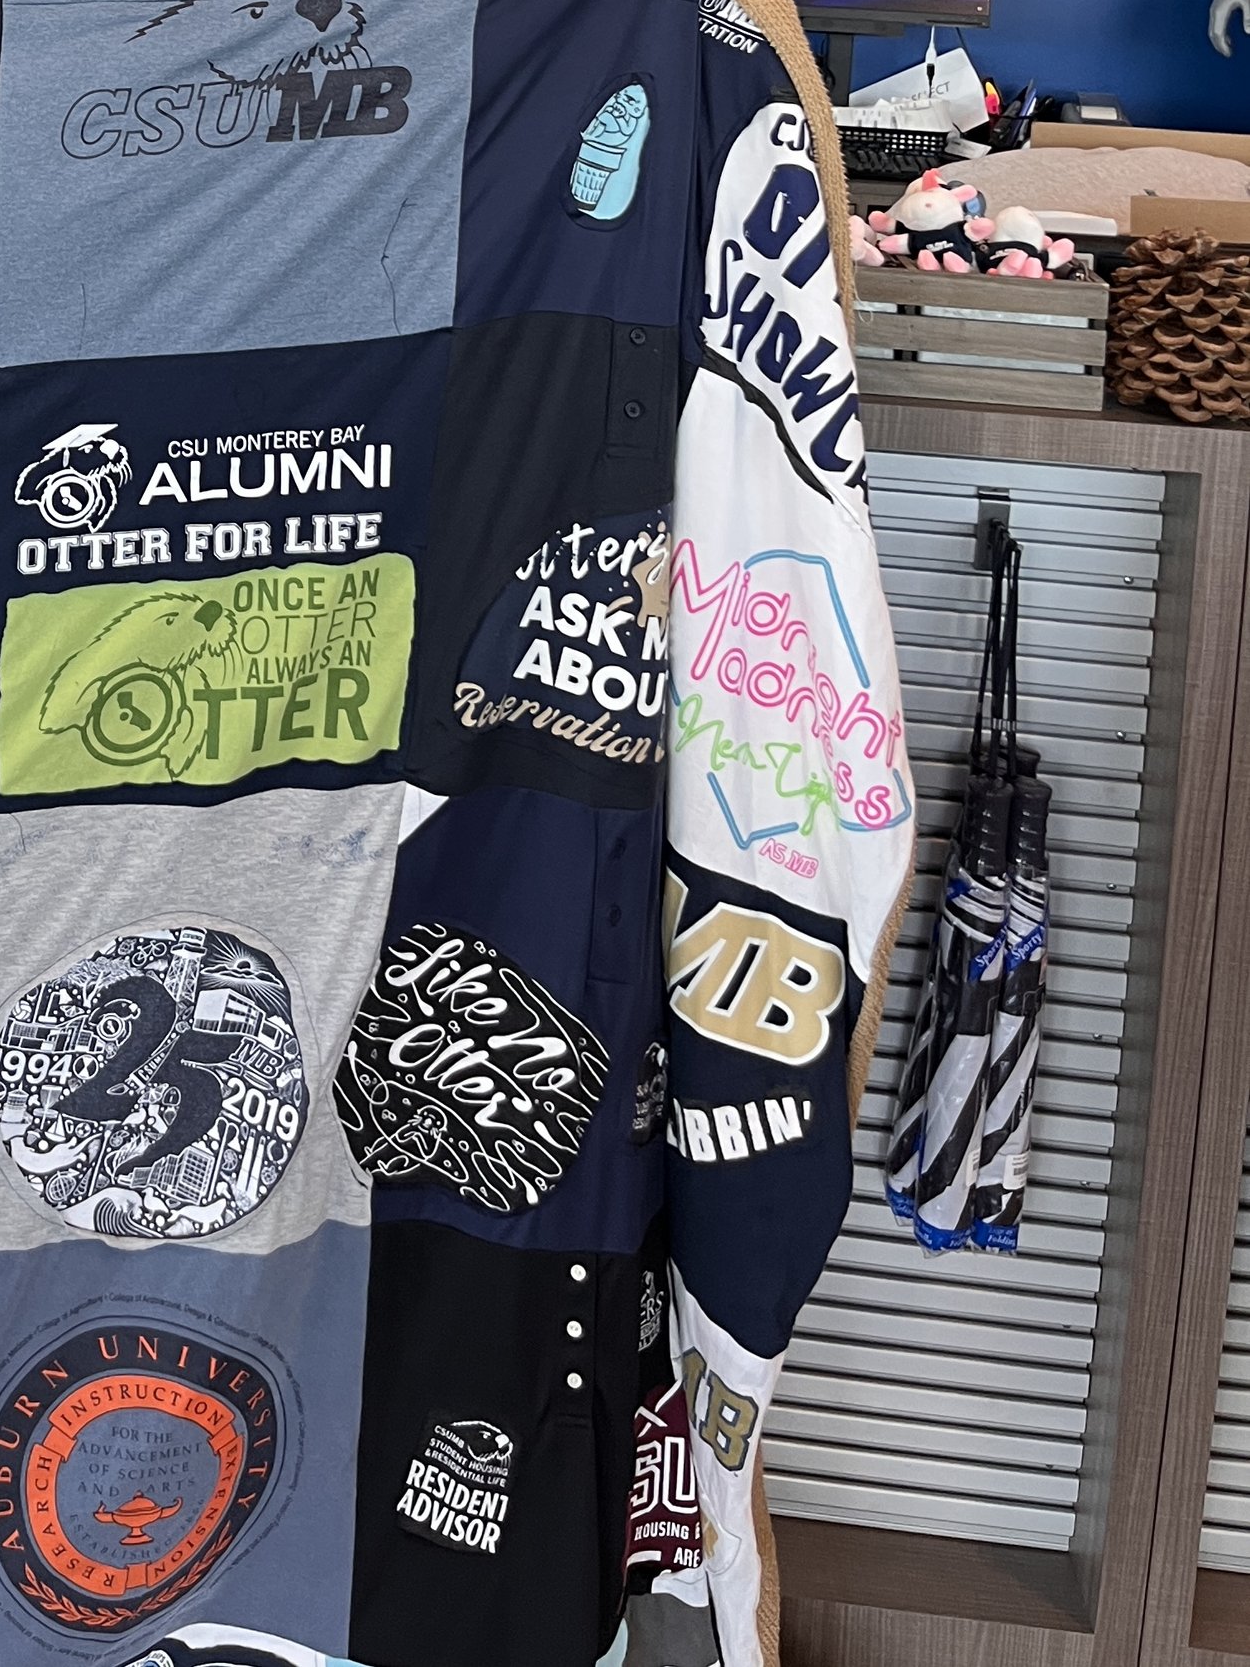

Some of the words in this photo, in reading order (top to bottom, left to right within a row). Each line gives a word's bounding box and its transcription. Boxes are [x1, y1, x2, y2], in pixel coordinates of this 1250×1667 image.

[60, 65, 413, 160] CSUMB
[167, 440, 209, 457] CSU
[216, 430, 325, 455] MONTEREY
[329, 424, 366, 445] BAY
[138, 444, 392, 506] ALUMNI
[17, 528, 172, 576] OTTER
[184, 519, 273, 562] FOR
[284, 511, 384, 555] LIFE
[233, 576, 327, 613] ONCE
[338, 568, 380, 605] AN
[241, 601, 377, 655] OTTER
[519, 586, 635, 657] ASK
[246, 645, 333, 685] ALWAYS
[339, 640, 372, 668] AN
[512, 637, 667, 718] ABOU
[384, 938, 508, 1025] Like
[221, 1076, 300, 1142] 2019
[60, 1383, 225, 1428] INSTRUCTION
[97, 1334, 272, 1509] UNIVERSITY
[77, 1440, 203, 1463] ADVANCEMENT
[111, 1426, 141, 1442] FOR
[144, 1431, 174, 1444] THE
[429, 1437, 468, 1466] STUDENT
[468, 1461, 509, 1477] HOUSING
[433, 1424, 466, 1449] CSUMB
[77, 1481, 121, 1498] AND
[144, 1477, 197, 1495] ARTS
[88, 1462, 110, 1476] OF
[117, 1461, 190, 1481] SCIENCE
[406, 1459, 510, 1522] RESIDENT
[431, 1449, 485, 1484] RESIDENTIAL
[487, 1476, 507, 1488] LIFE
[35, 1455, 116, 1588] RESEARCH
[152, 1444, 239, 1579] EXTENSION
[396, 1487, 502, 1554] ADVISOR
[634, 1523, 690, 1541] HOUSING
